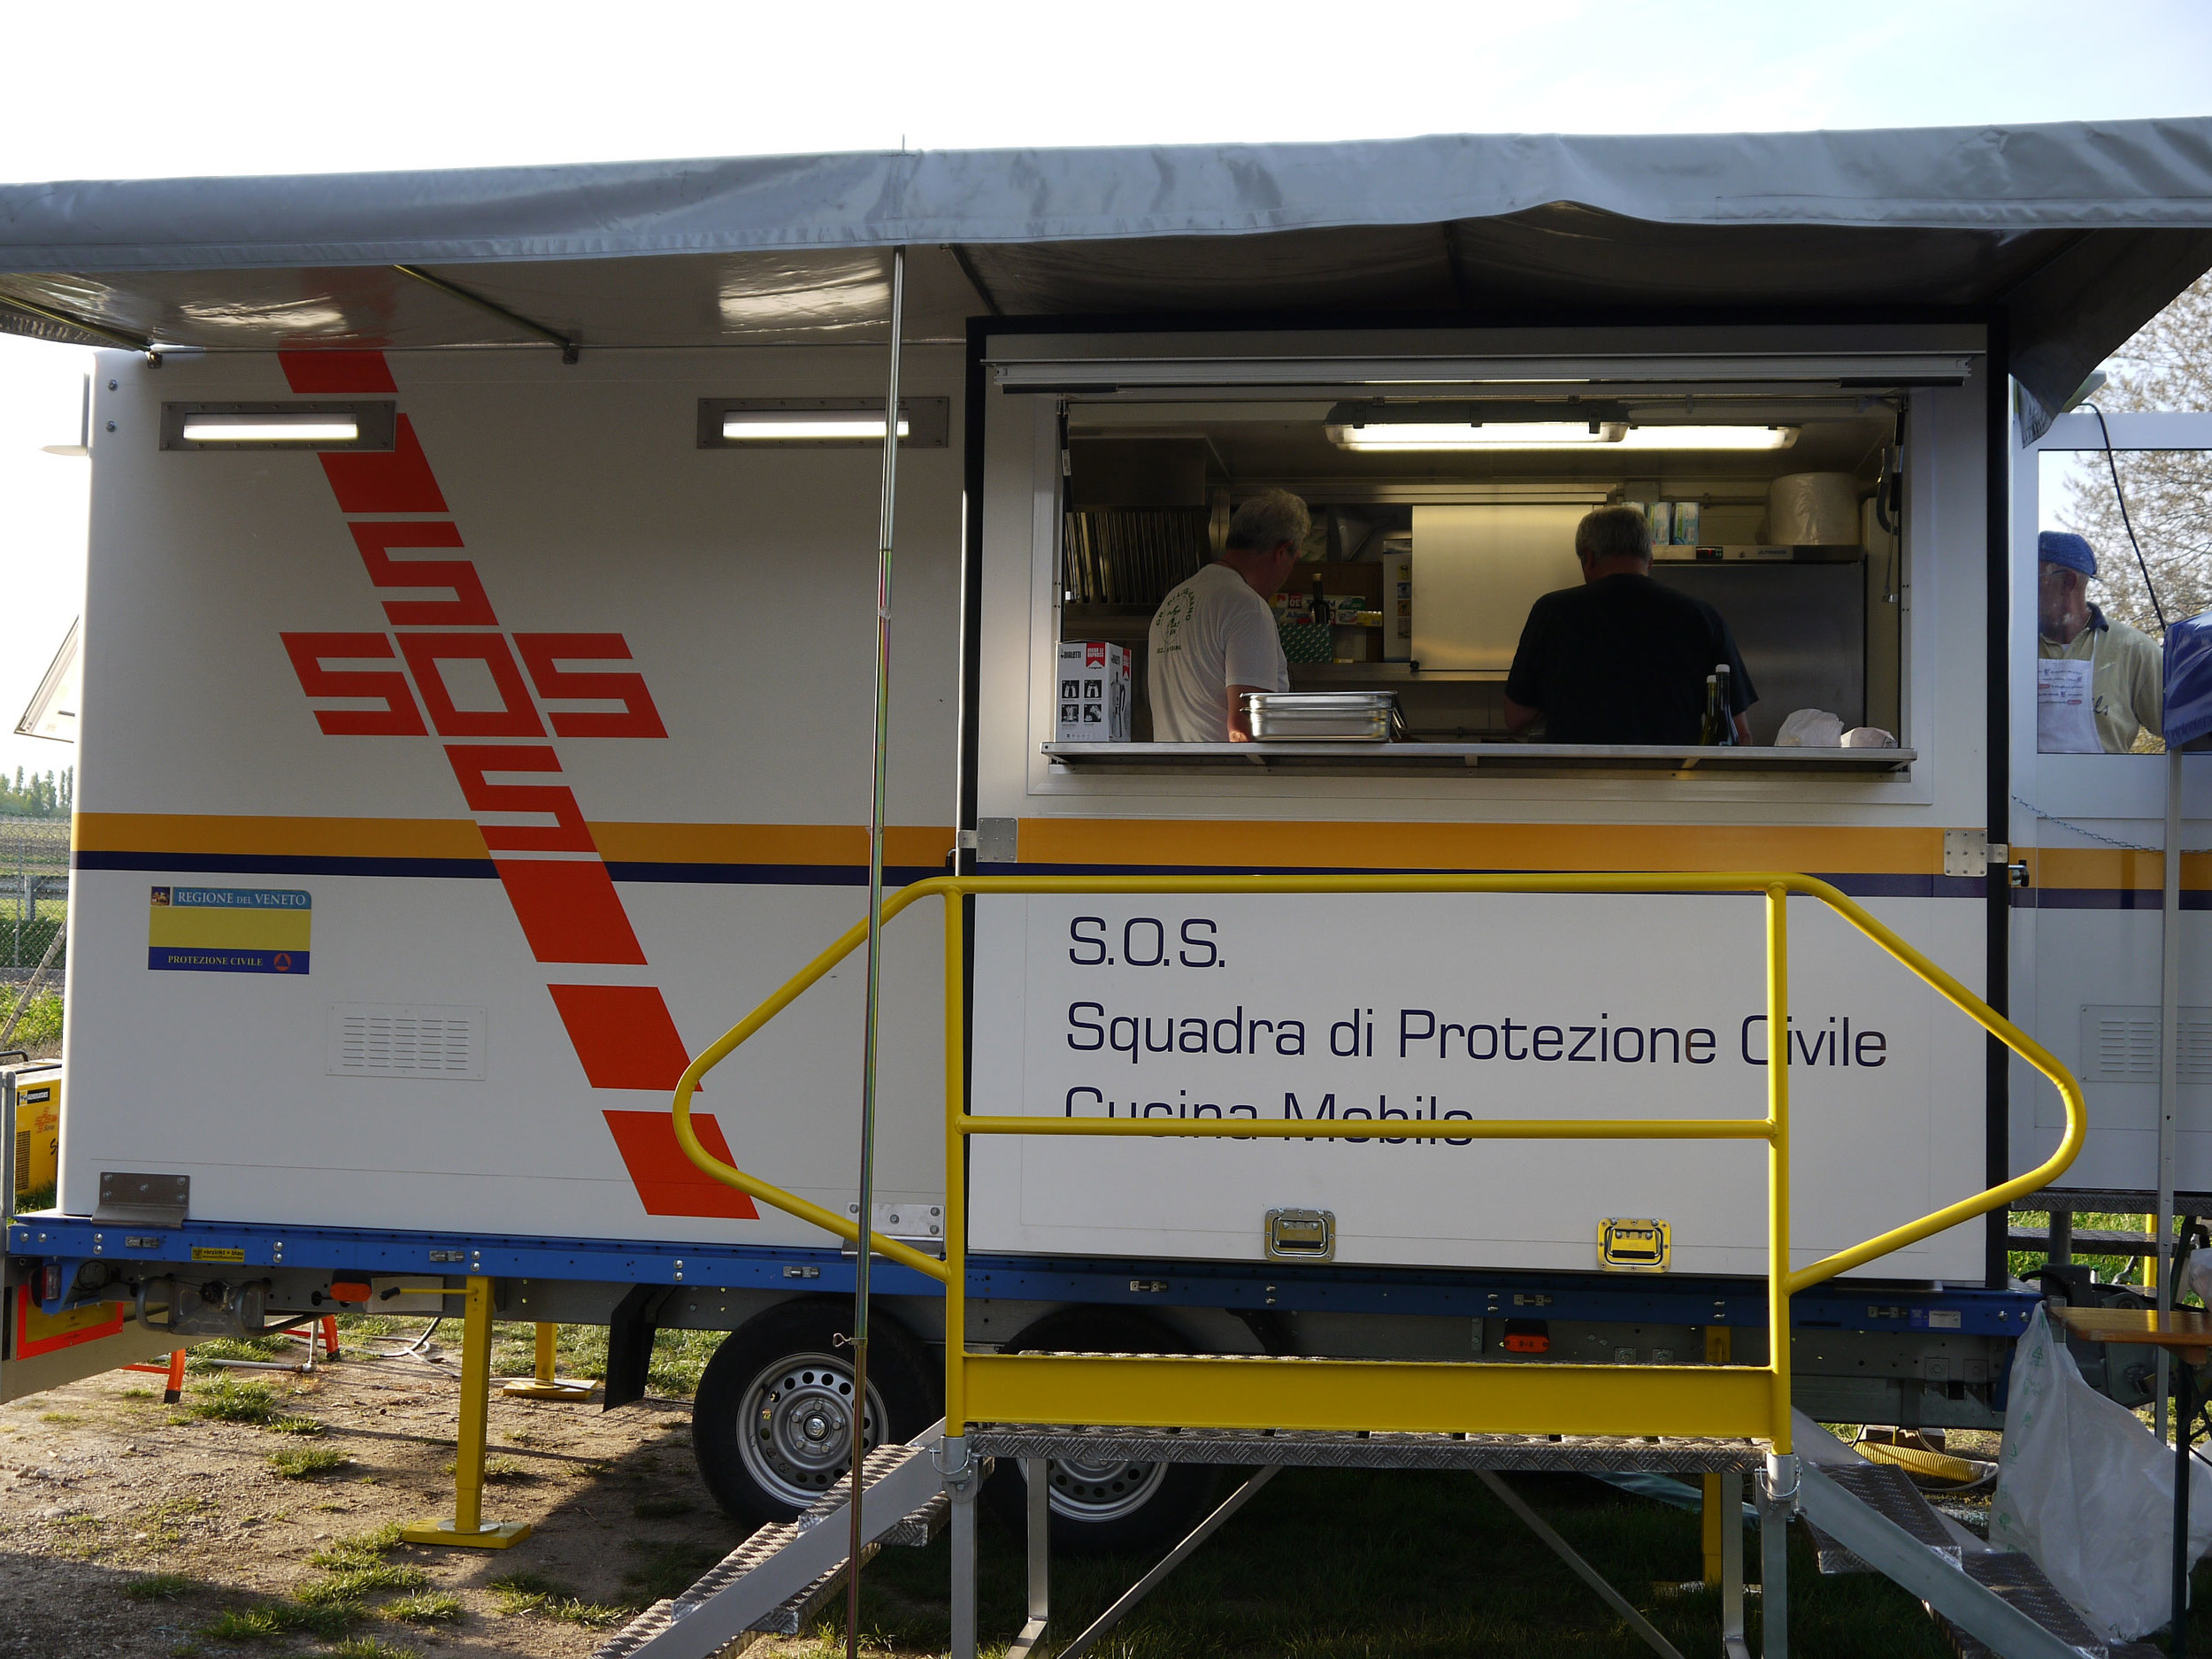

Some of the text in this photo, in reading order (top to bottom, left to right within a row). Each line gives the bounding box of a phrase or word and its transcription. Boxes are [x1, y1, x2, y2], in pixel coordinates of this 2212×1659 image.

[178, 891, 234, 903] REGIONE
[255, 894, 305, 905] VENETO
[1069, 916, 1225, 967] S.O.S.
[168, 955, 263, 966] PROTEZIONE CIVILE
[1067, 1002, 1886, 1067] Squadra di Protezione Civile
